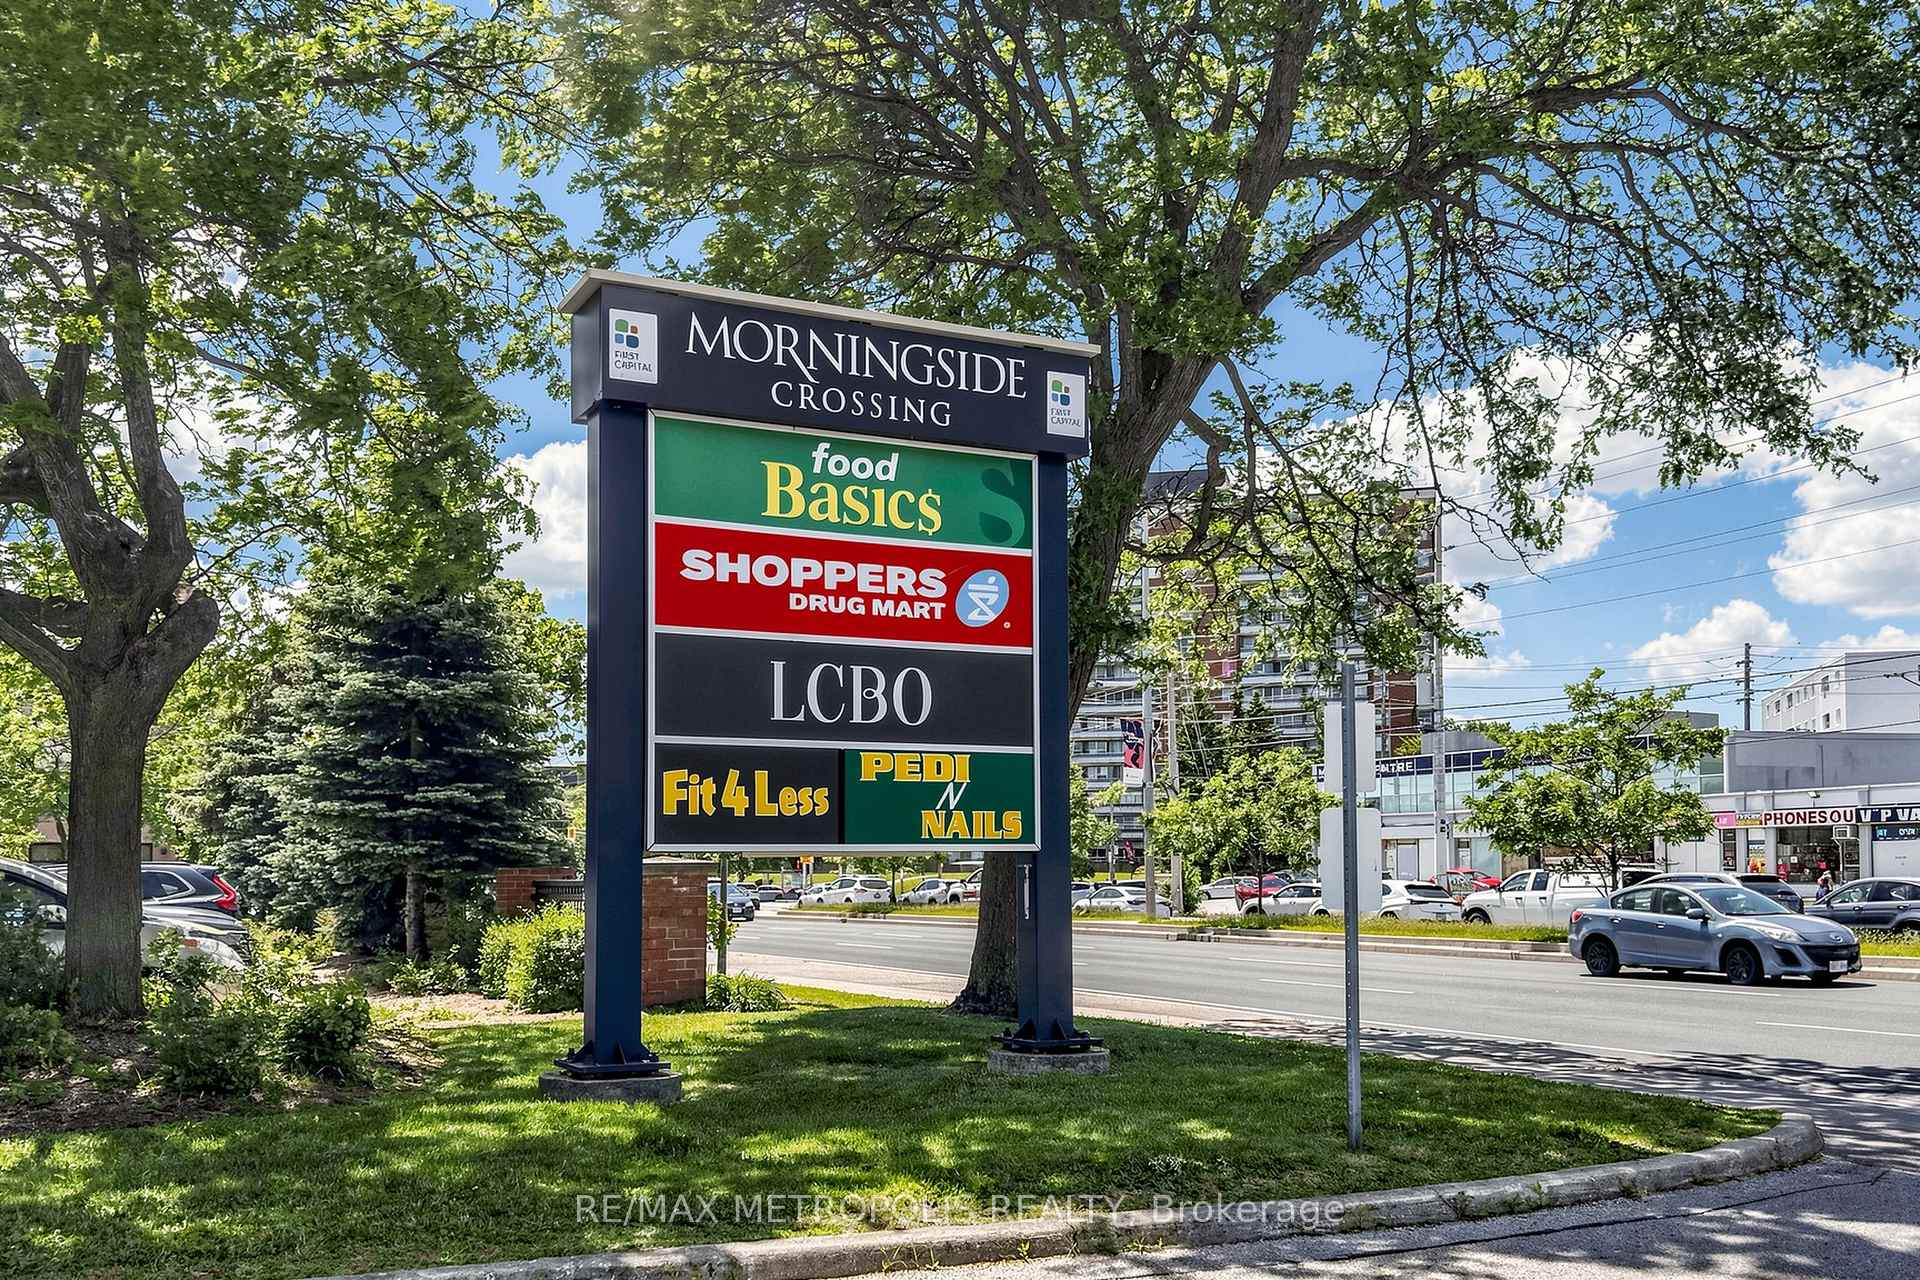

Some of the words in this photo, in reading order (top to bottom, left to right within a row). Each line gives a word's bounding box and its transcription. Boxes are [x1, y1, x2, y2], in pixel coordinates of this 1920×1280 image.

[614, 360, 653, 373] CAPITAL
[615, 350, 639, 360] FIRST
[685, 311, 1027, 398] MORNINGSIDE
[770, 381, 952, 427] CROSSING
[811, 442, 900, 482] food
[680, 549, 947, 598] SHOPPERS
[789, 593, 866, 616] DRUG
[872, 599, 946, 620] MART
[770, 660, 932, 726] LCBO
[859, 752, 971, 783] PEDI
[662, 769, 716, 817] Fit
[720, 769, 750, 817] 4
[754, 771, 830, 817] Less
[935, 782, 968, 810] N
[920, 810, 1023, 839] NAILS
